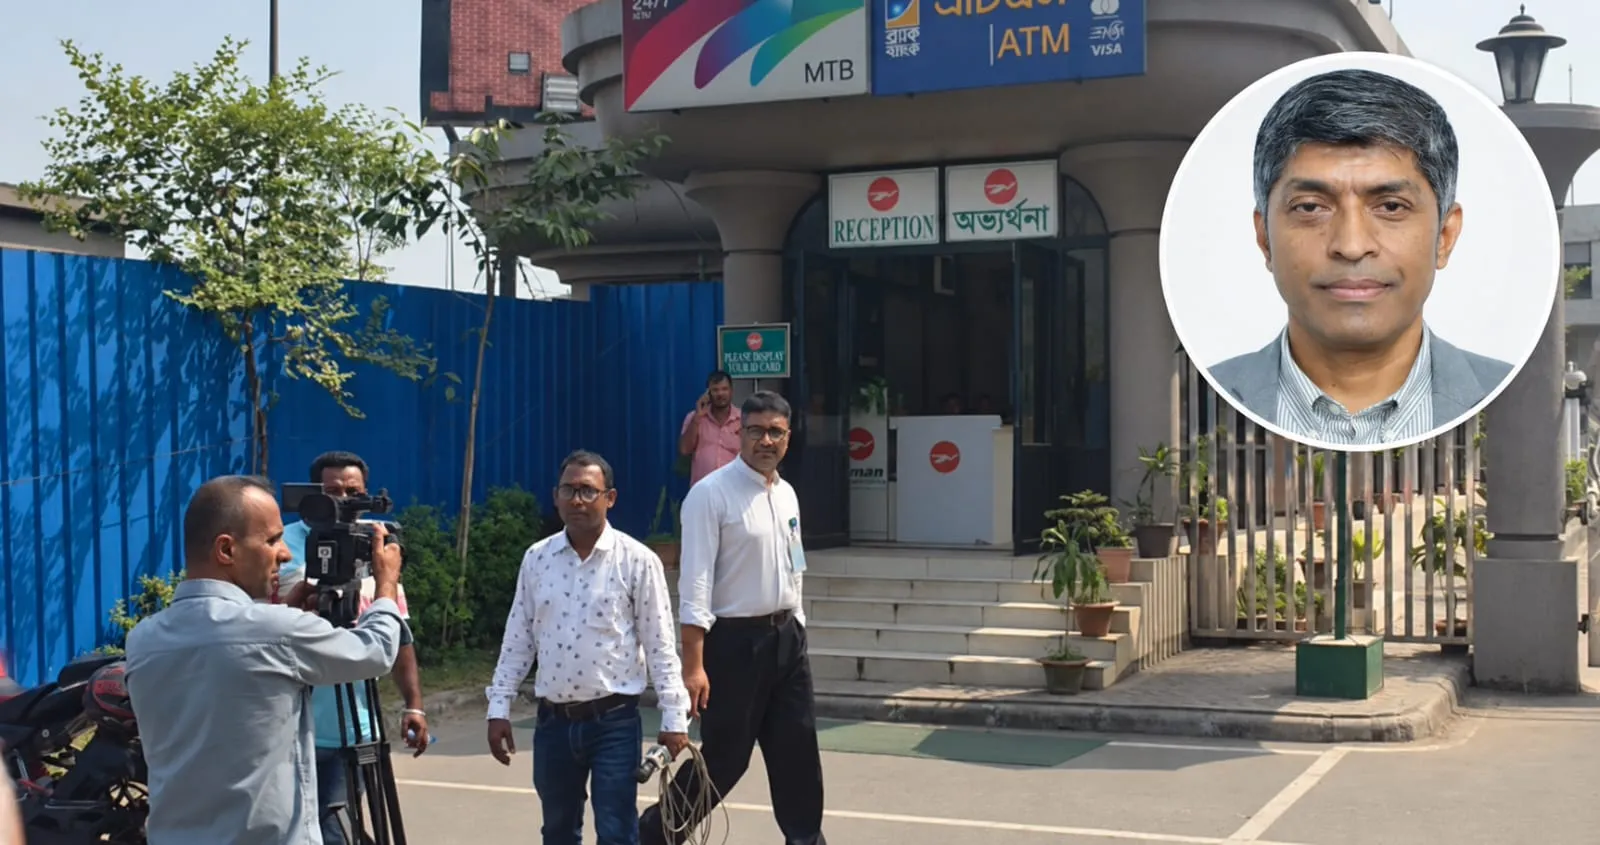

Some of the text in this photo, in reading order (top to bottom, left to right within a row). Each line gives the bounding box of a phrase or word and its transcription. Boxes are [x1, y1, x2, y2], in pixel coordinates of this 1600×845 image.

[997, 23, 1070, 58] ATM
[1090, 43, 1122, 56] VISA
[804, 59, 854, 83] MTB
[952, 198, 1049, 234] অভ্যর্থনা
[834, 214, 934, 243] RECEPTION
[724, 351, 784, 362] PLEASE DISPLAY
[760, 361, 782, 371] CARD
